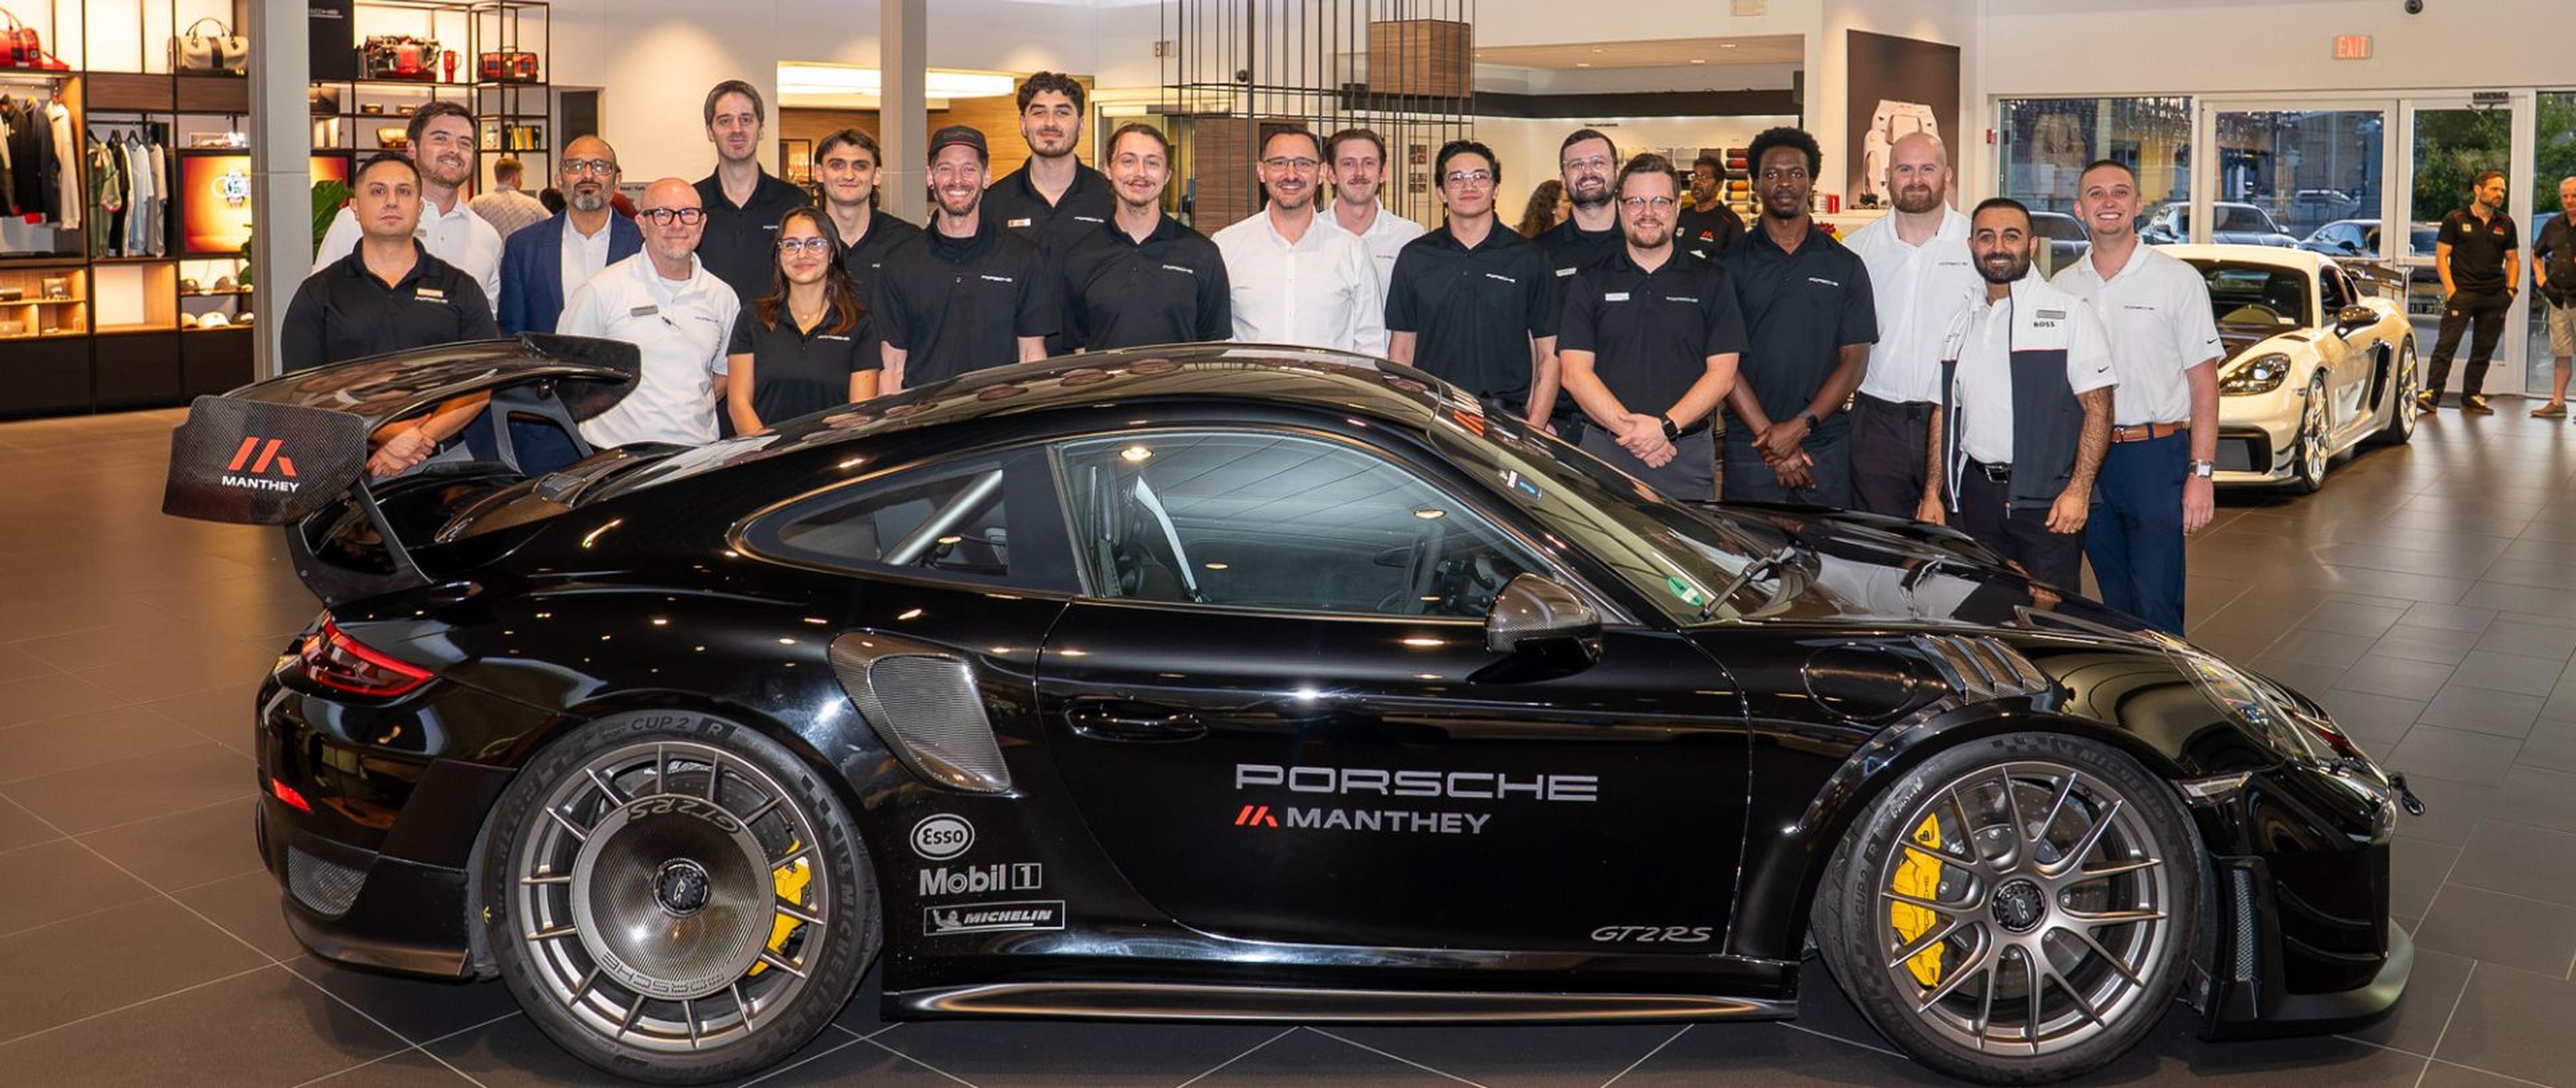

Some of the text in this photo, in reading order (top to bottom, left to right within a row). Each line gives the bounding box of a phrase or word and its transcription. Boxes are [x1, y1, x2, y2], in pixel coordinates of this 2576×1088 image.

[2338, 36, 2367, 59] EXIT
[221, 475, 300, 493] MANTHEY
[631, 717, 673, 731] CUP
[676, 716, 690, 730] 2
[706, 722, 724, 737] R
[1236, 763, 1599, 802] PORSCHE
[1286, 807, 1491, 834] MANTHEY
[922, 828, 964, 845] Esso
[919, 863, 1006, 896] Mobil
[963, 910, 1053, 924] MICHELIN
[600, 950, 726, 993] PORSCHE
